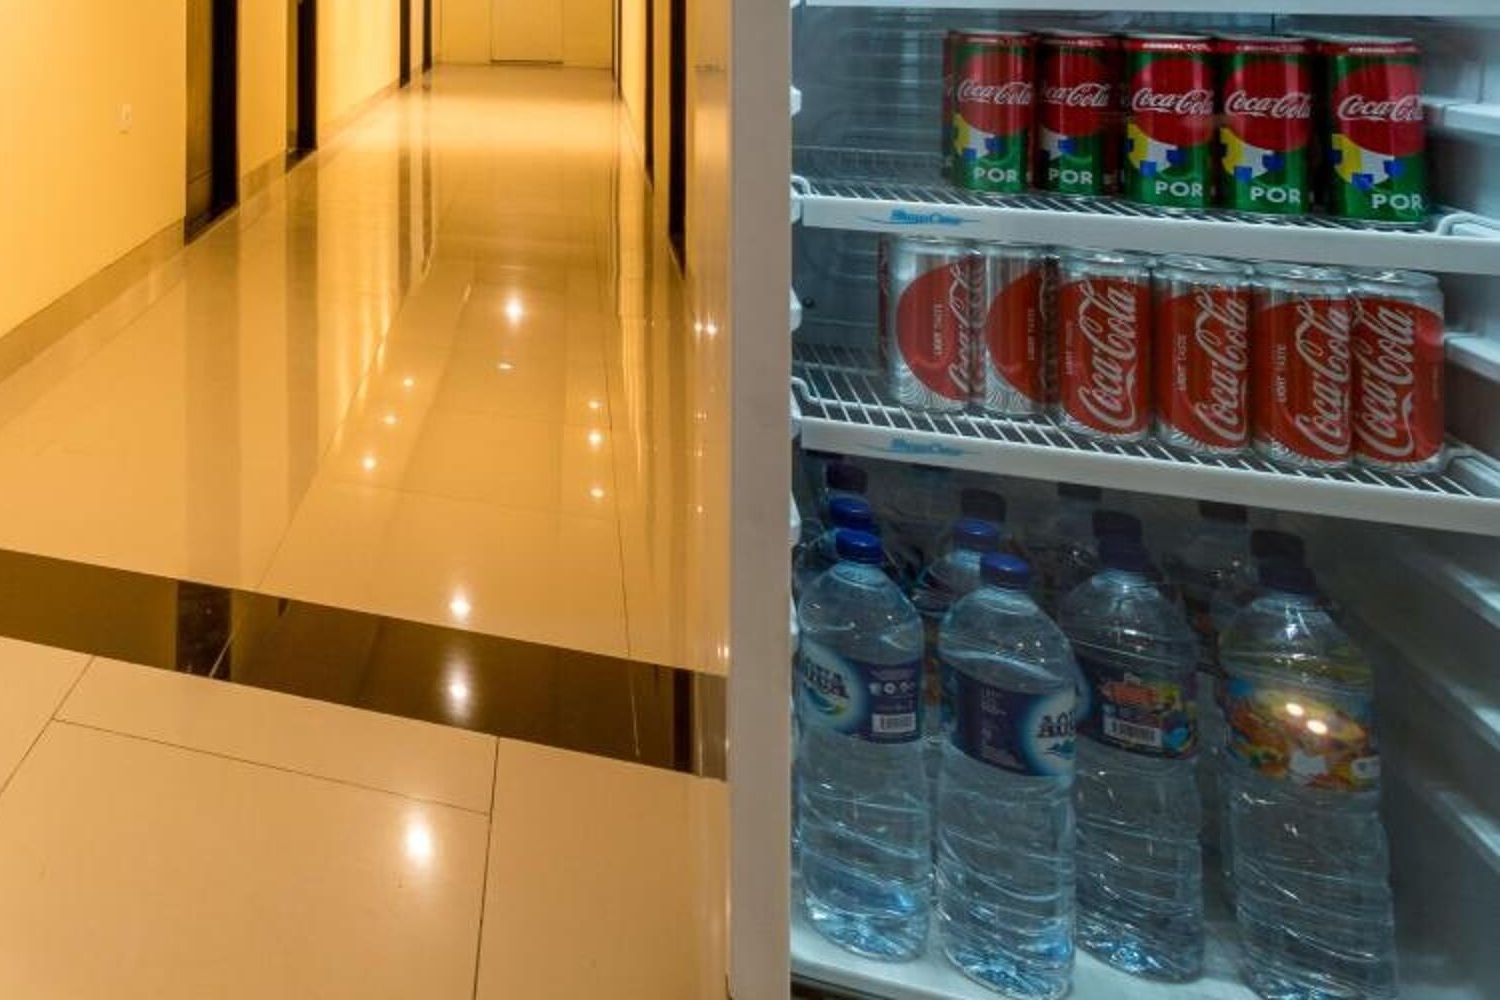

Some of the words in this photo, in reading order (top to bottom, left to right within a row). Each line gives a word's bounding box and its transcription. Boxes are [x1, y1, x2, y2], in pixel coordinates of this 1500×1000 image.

[973, 168, 1018, 183] POR
[1048, 169, 1093, 184] POR
[1155, 180, 1203, 197] POR
[1251, 186, 1300, 203] POR
[1371, 193, 1423, 211] POR
[1077, 279, 1137, 428] Coca-Cola
[1194, 288, 1248, 441] Coca-Cola
[1294, 296, 1350, 455] Coca-Cola
[1350, 294, 1414, 456] Coca-Cola
